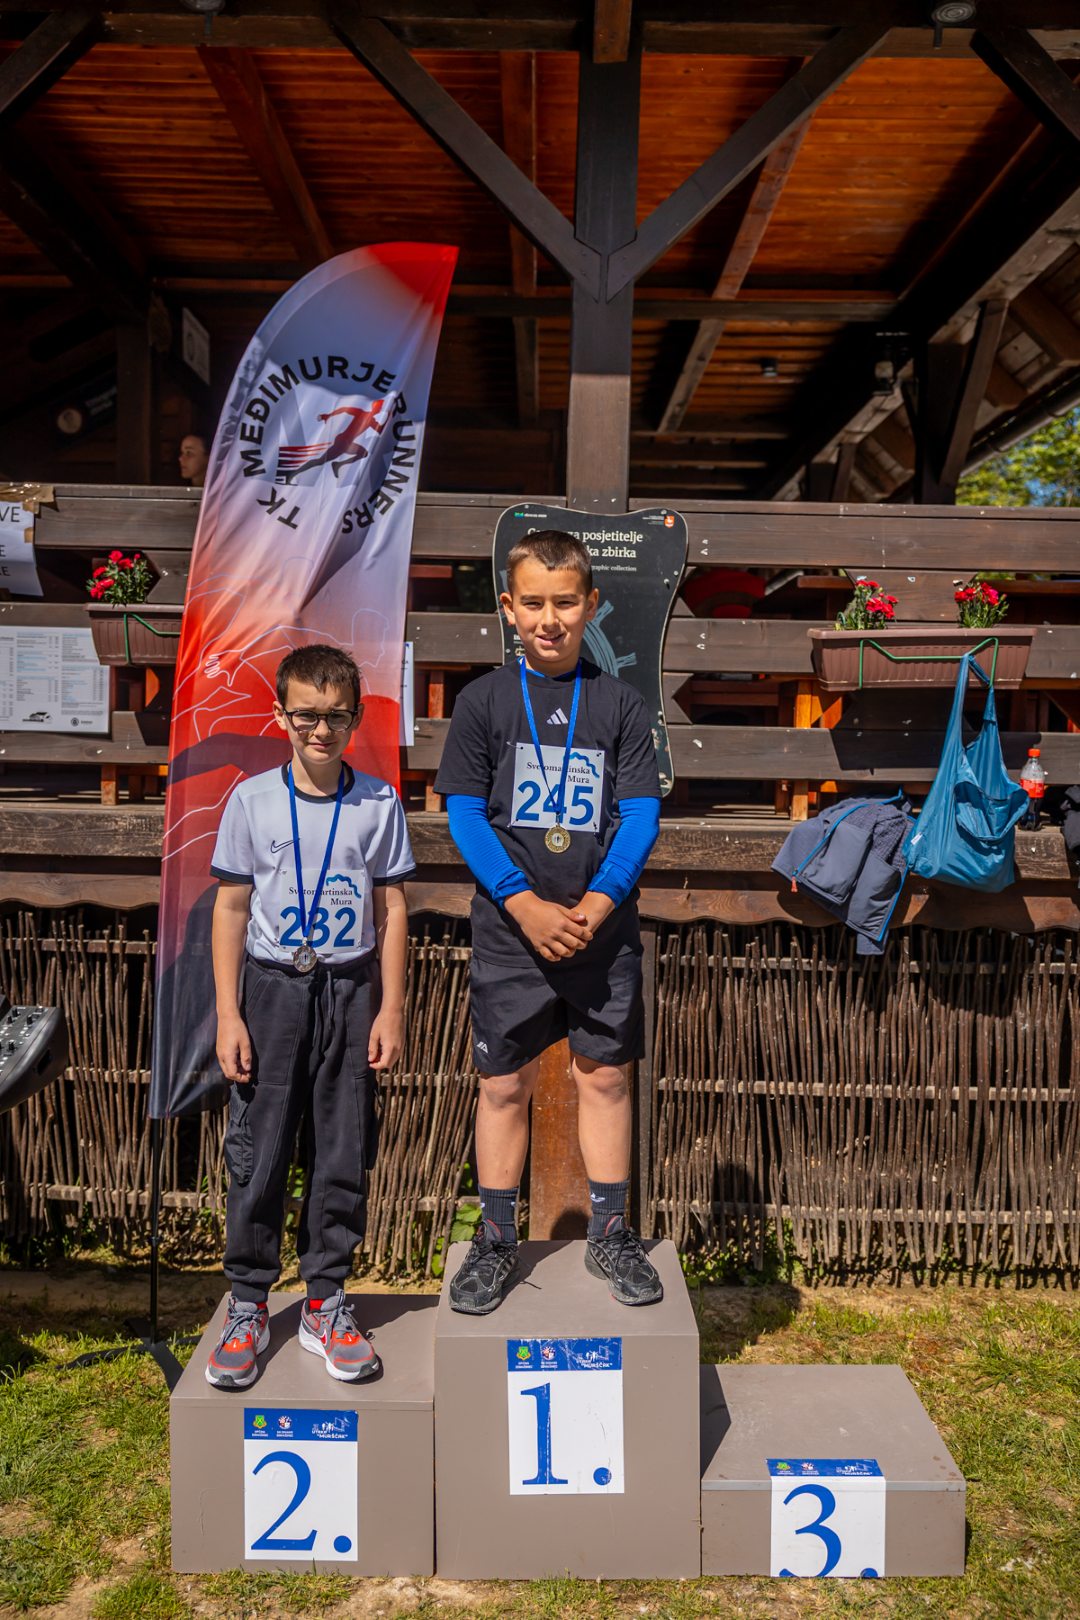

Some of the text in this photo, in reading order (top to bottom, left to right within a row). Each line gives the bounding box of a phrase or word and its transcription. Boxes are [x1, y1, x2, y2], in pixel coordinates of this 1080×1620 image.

[240, 355, 416, 534] TK MEĐIMURJE RUNNERS
[582, 529, 643, 544] posjetitelje
[601, 546, 637, 558] zbirka
[610, 564, 637, 572] collection
[527, 761, 591, 774] Sveomainska
[567, 775, 590, 784] Mura
[515, 780, 594, 826] 245
[330, 897, 352, 906] Mura
[280, 905, 357, 948] 232
